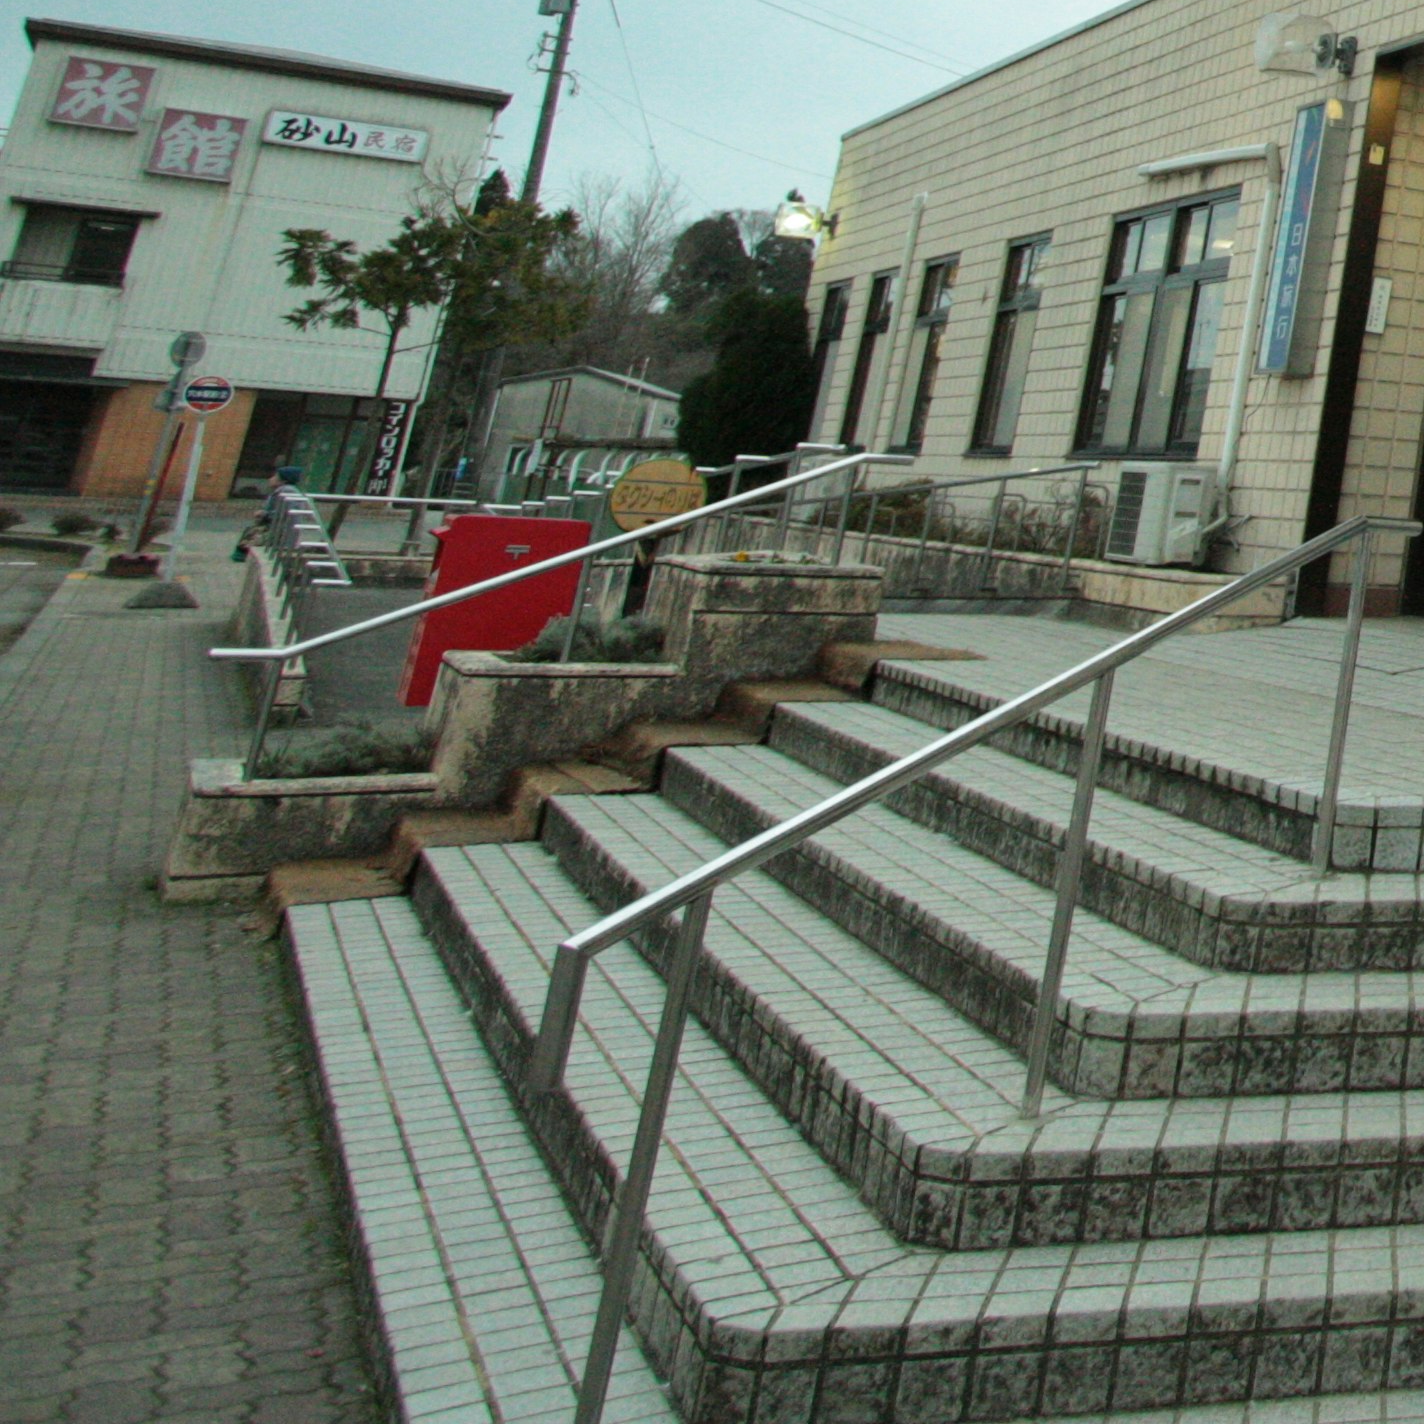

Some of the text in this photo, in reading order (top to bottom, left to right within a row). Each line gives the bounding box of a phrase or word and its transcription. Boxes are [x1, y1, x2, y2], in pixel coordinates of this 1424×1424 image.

[56, 63, 242, 176] 旅館
[274, 117, 419, 155] 砂山民宿
[1274, 222, 1304, 341] 日本旅行
